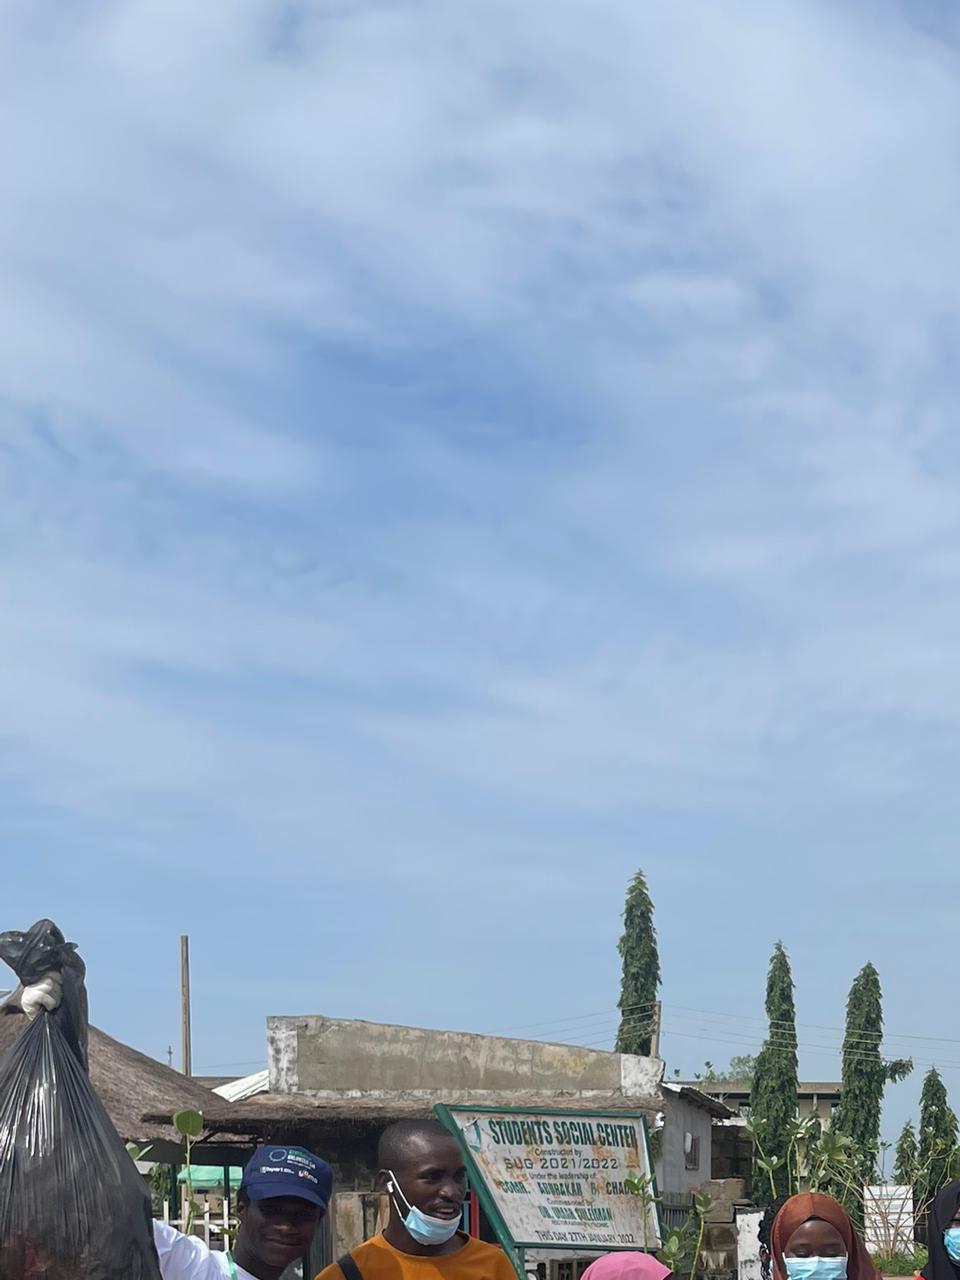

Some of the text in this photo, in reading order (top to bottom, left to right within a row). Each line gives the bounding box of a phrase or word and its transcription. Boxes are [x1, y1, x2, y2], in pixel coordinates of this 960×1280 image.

[488, 1120, 639, 1149] STUDENTS SOCIAL CENTER
[504, 1157, 618, 1170] SUG 2021/2022
[547, 1172, 558, 1180] the
[535, 1229, 554, 1242] THIS
